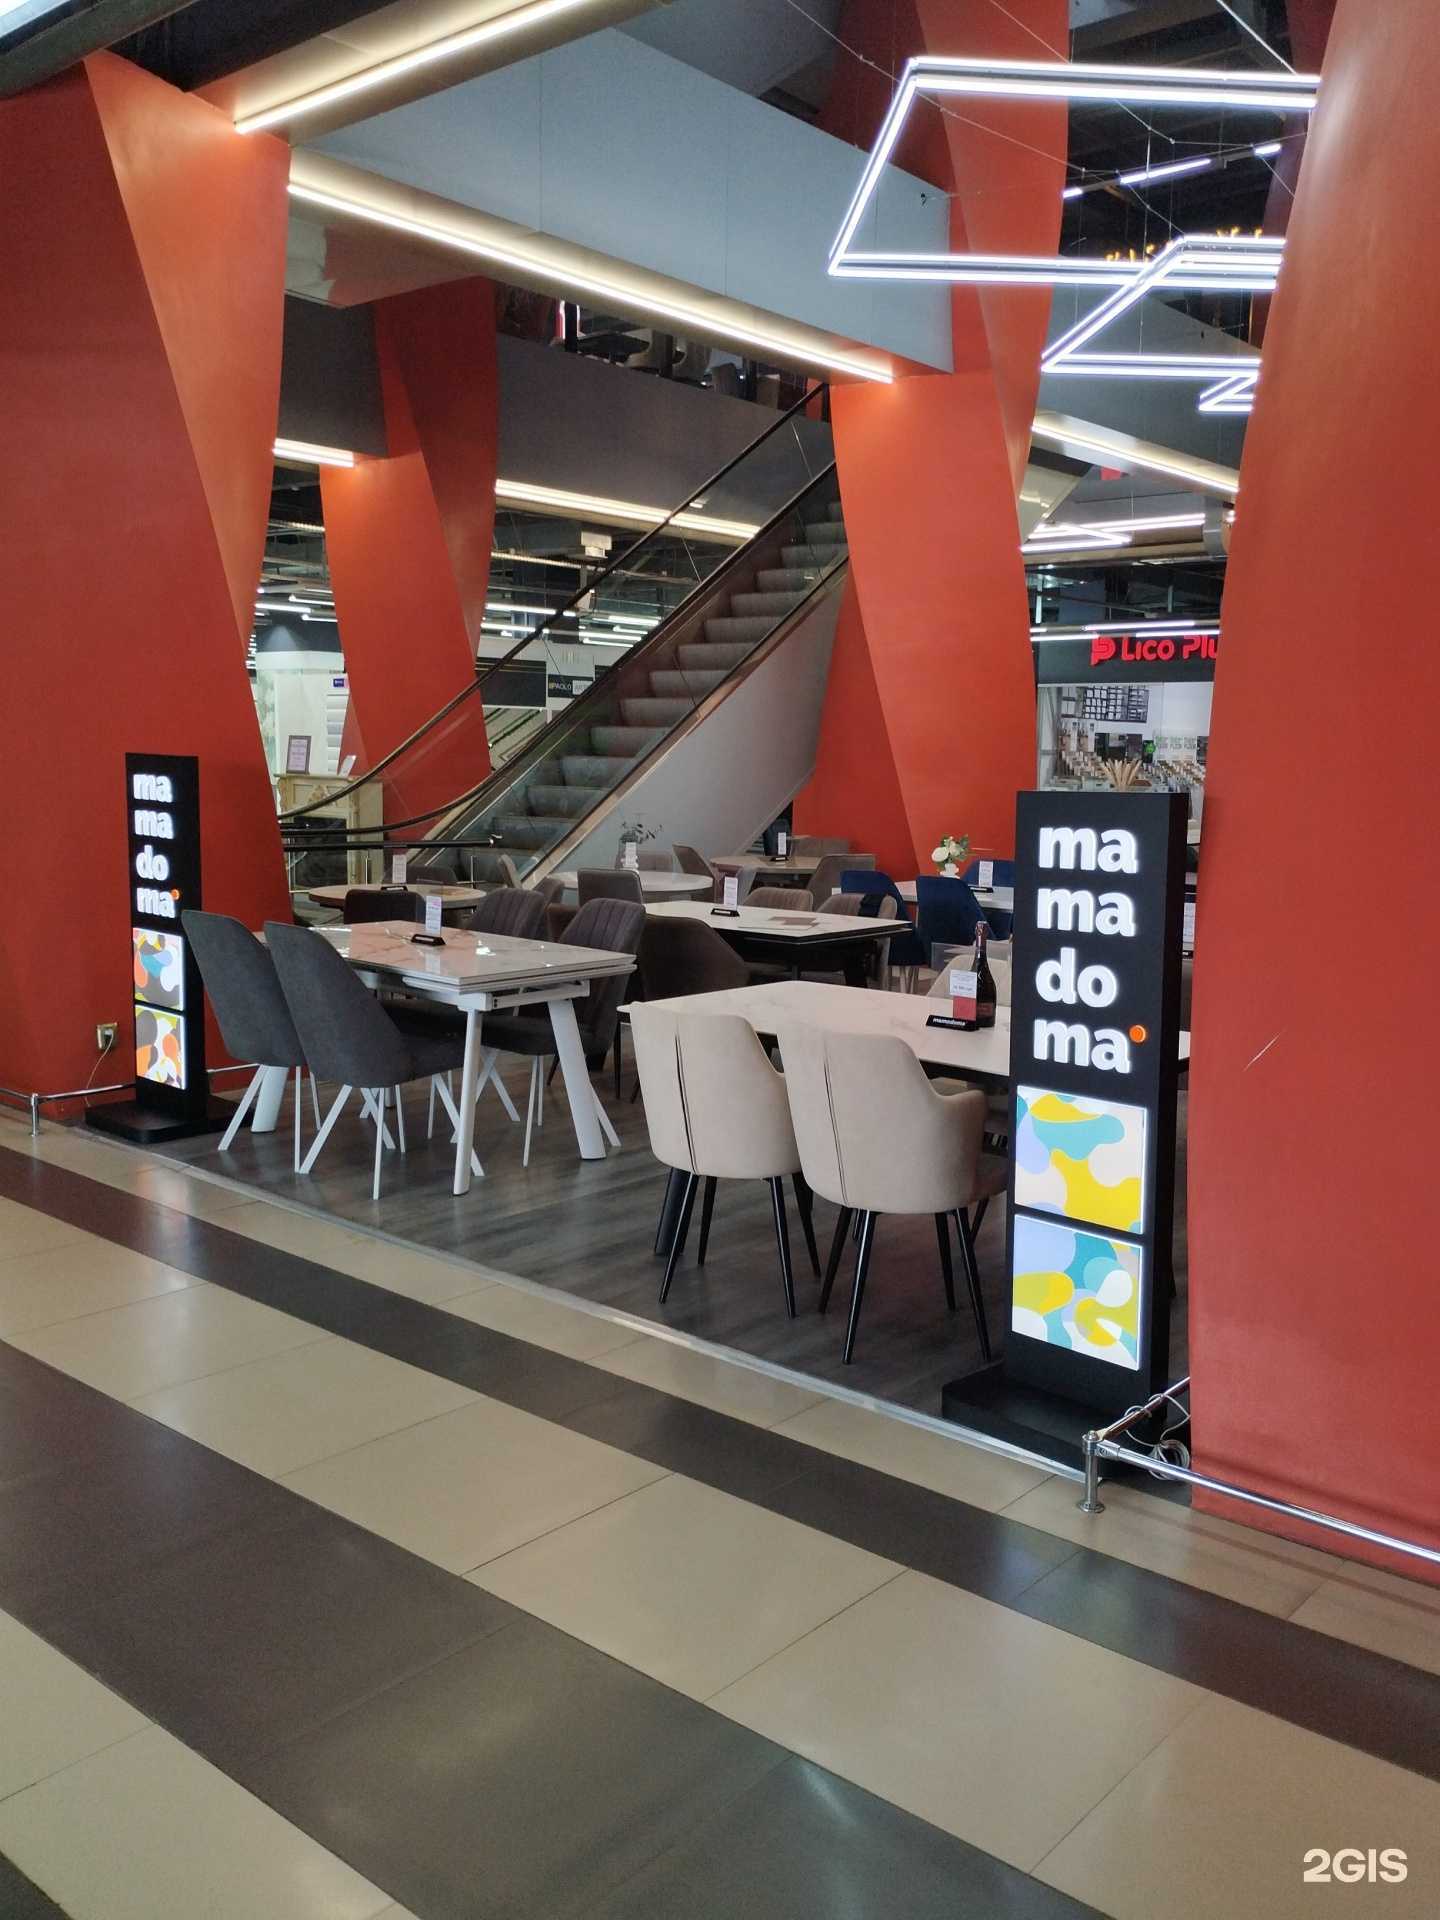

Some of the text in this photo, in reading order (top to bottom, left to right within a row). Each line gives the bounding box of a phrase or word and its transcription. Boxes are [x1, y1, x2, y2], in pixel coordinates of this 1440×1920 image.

[133, 773, 173, 803] ma
[134, 809, 174, 840] ma
[136, 844, 170, 881] do
[1038, 827, 1139, 874] ma
[137, 887, 176, 919] ma
[1036, 887, 1136, 937] ma
[1035, 947, 1119, 1008] do
[1033, 1018, 1132, 1074] ma
